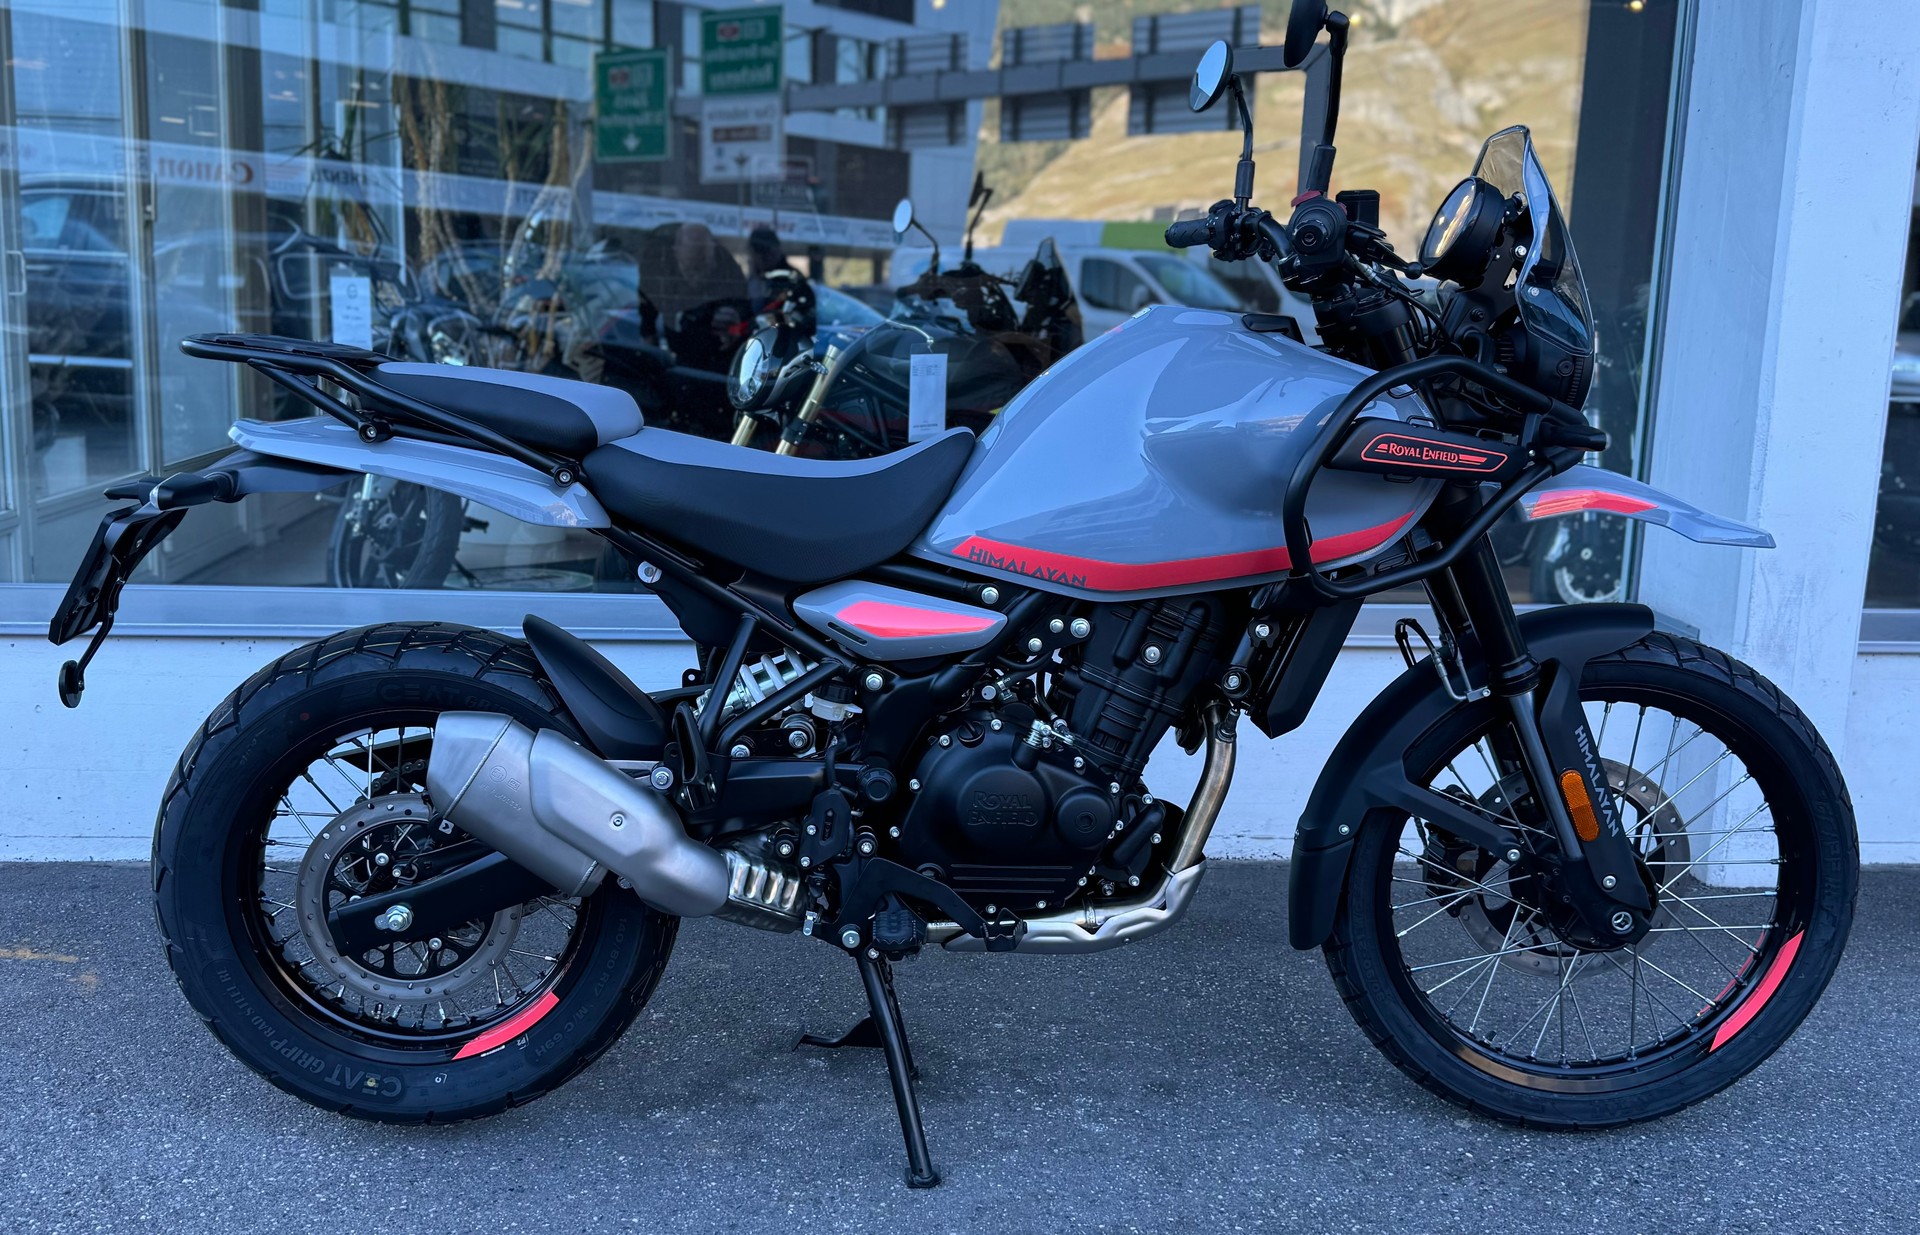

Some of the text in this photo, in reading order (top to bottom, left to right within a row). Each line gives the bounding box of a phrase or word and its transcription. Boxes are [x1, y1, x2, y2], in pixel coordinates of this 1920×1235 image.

[1389, 442, 1459, 464] ROYAL ENFIELD
[968, 545, 1088, 588] HIMALAYAN
[1574, 724, 1619, 838] HIMALAYAN
[971, 790, 1033, 811] ROYAL
[967, 808, 1040, 828] ENFIELD
[226, 984, 256, 1017] STEEL
[251, 1015, 276, 1038] RAD
[269, 1038, 327, 1074] GRIPP
[533, 1032, 565, 1058] 69H
[324, 1063, 402, 1098] CEAT
